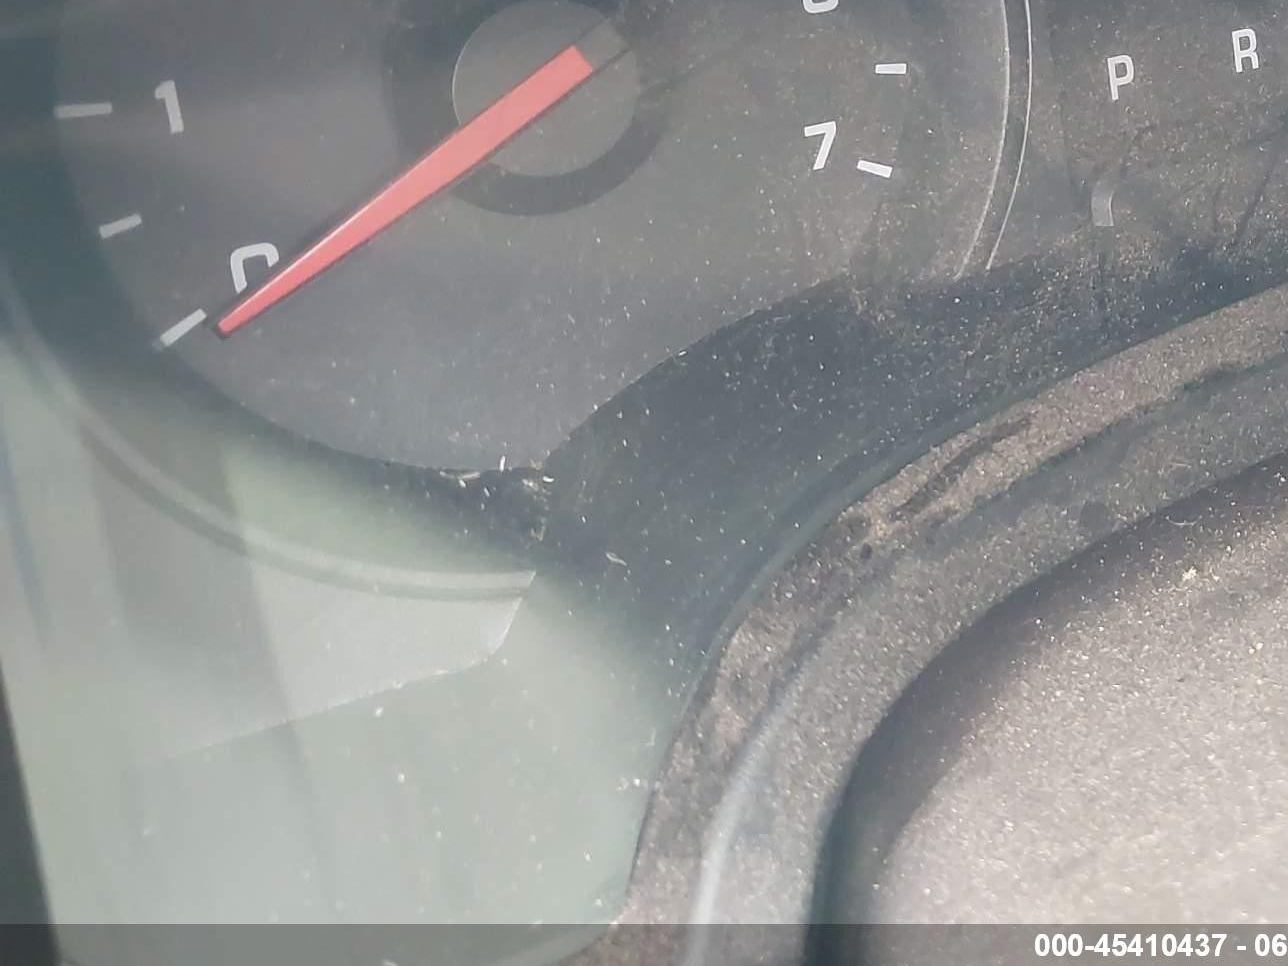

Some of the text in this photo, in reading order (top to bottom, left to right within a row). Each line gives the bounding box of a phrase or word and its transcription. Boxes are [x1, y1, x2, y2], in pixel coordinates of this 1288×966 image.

[1107, 53, 1135, 101] P
[1231, 27, 1260, 73] R
[154, 79, 184, 134] 1
[803, 120, 838, 172] 7
